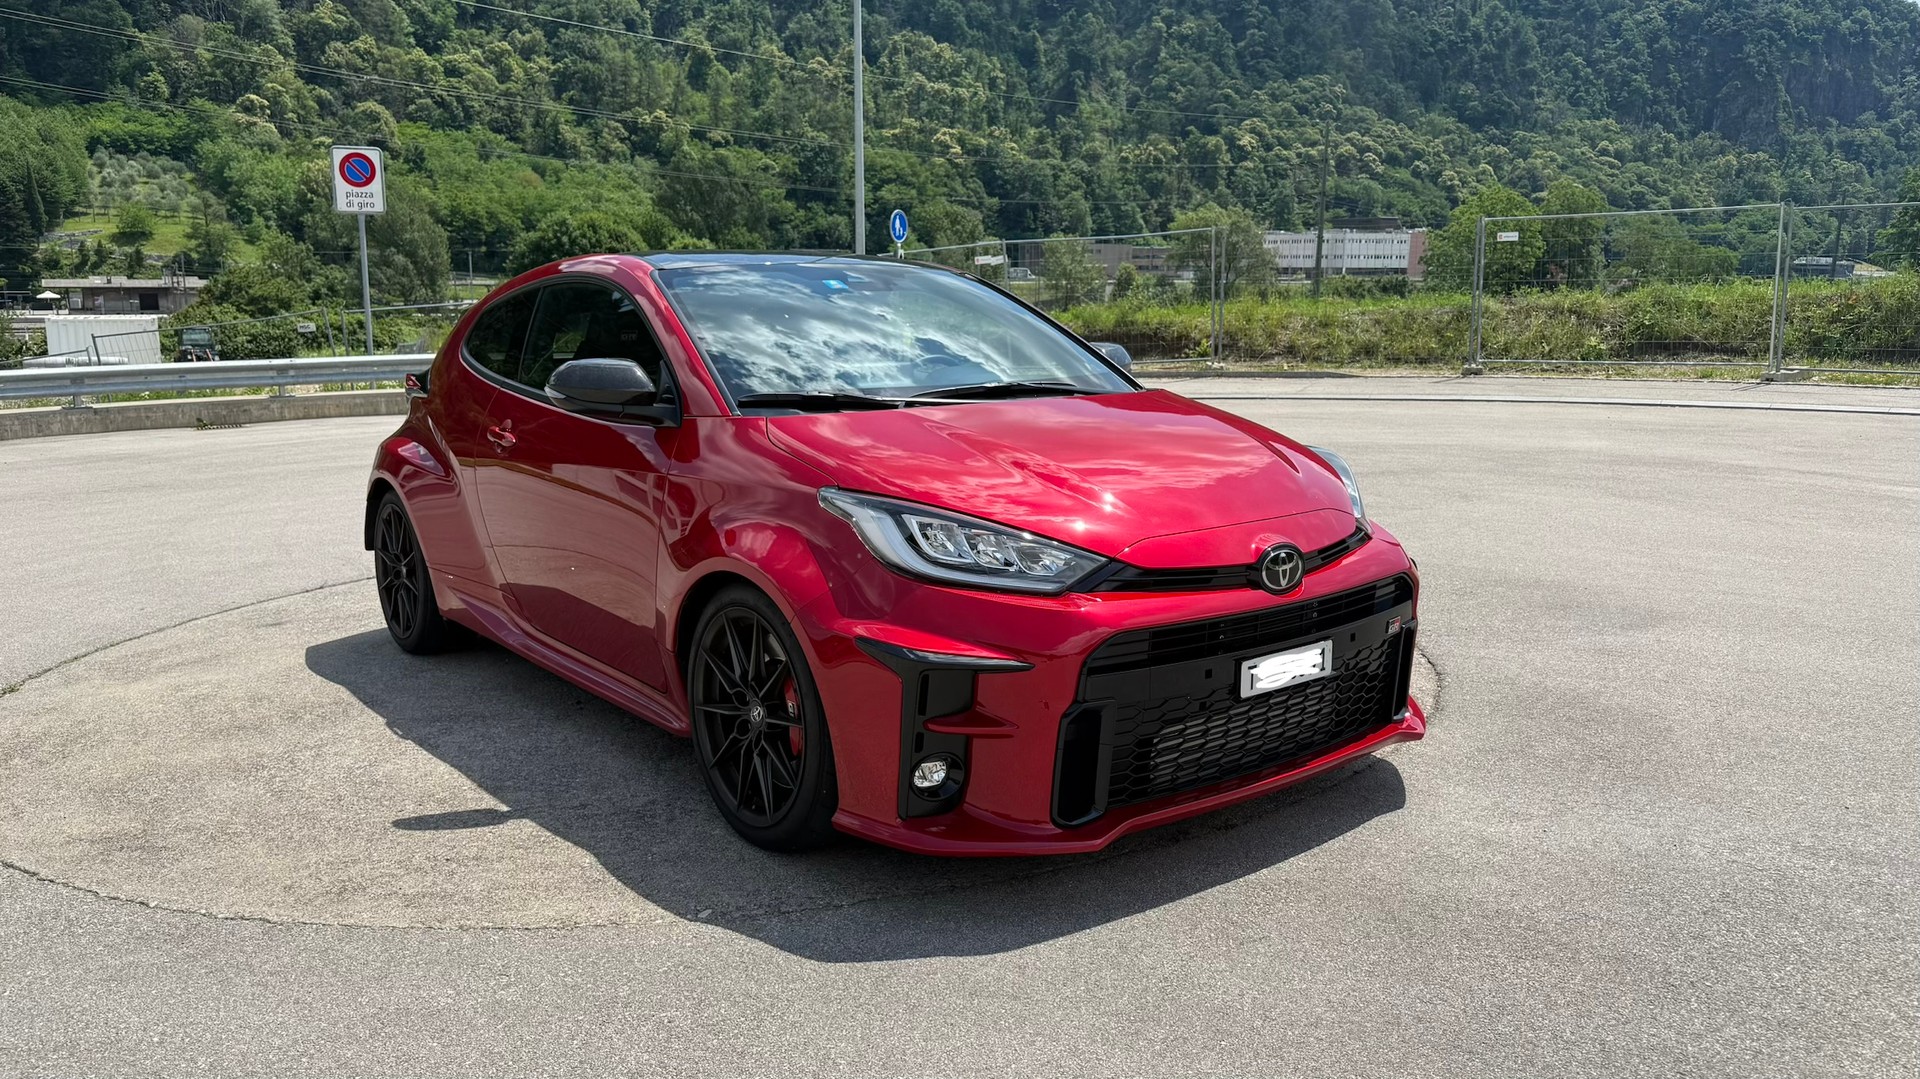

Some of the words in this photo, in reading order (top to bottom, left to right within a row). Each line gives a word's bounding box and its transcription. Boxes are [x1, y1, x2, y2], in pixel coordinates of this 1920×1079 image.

[345, 189, 374, 200] piazza
[346, 199, 355, 208] di
[357, 200, 375, 210] giro
